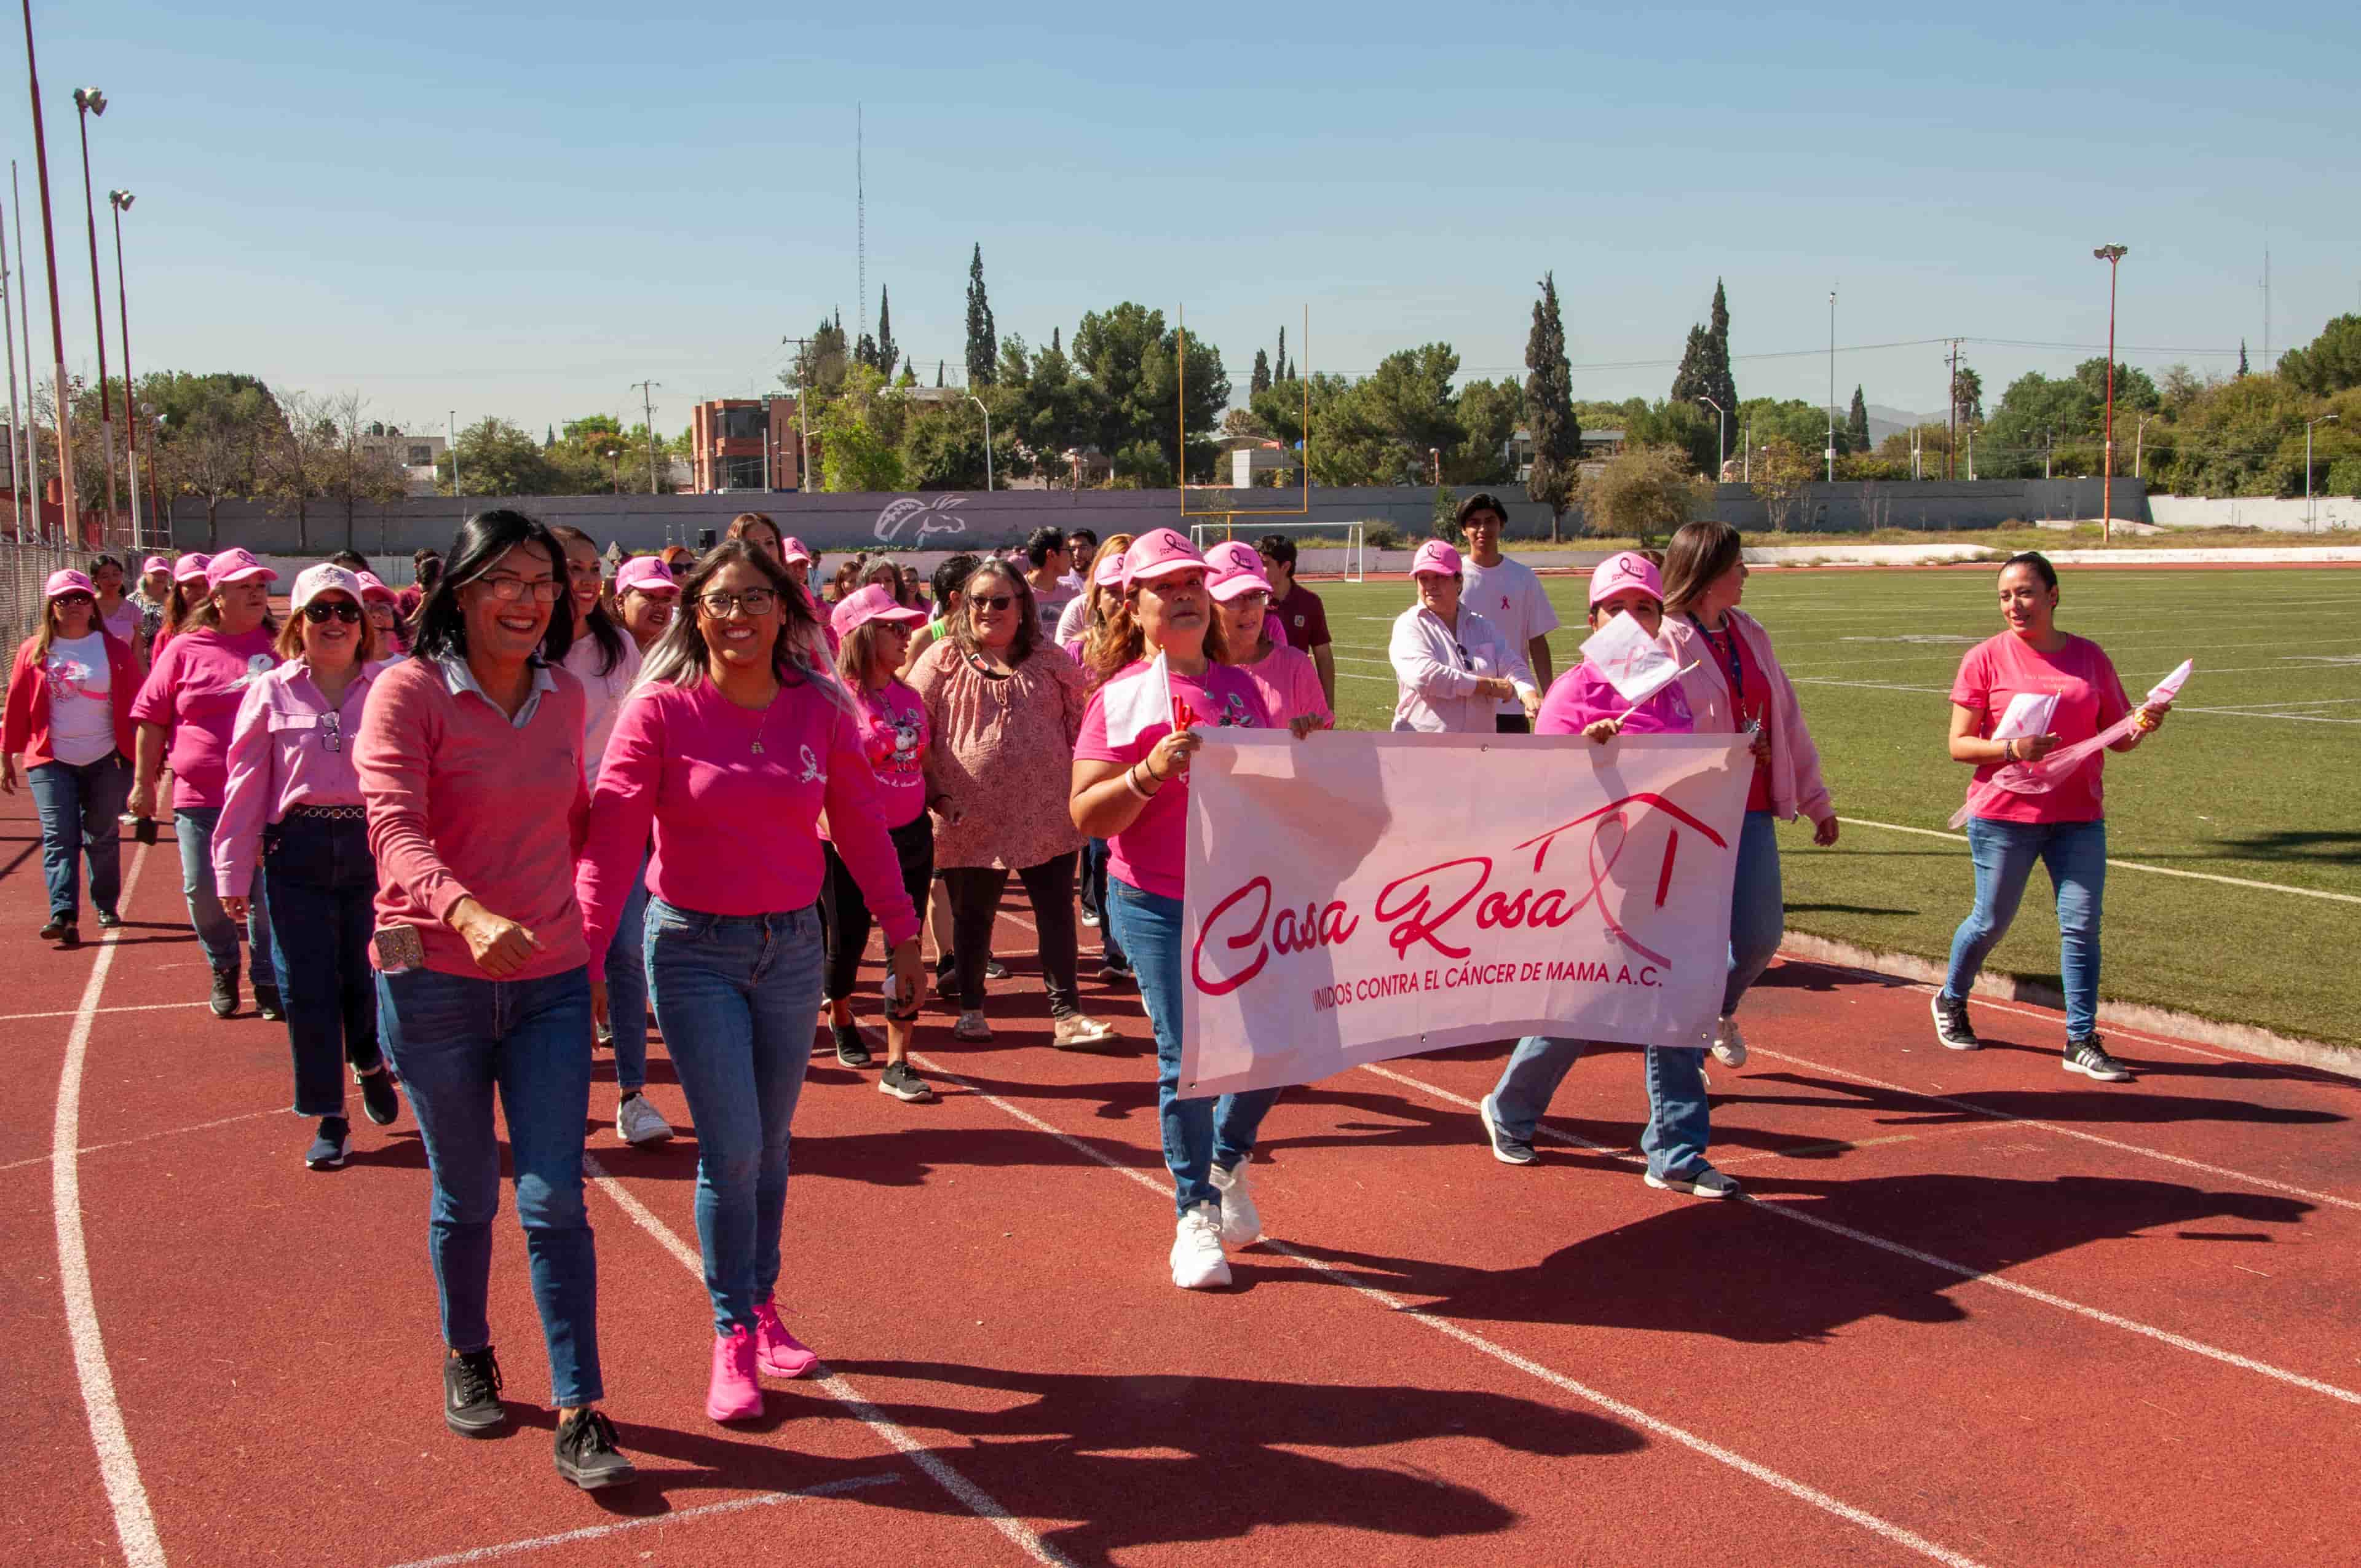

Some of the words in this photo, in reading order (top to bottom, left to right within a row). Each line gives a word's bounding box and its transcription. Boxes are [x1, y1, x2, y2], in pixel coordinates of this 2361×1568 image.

[1192, 875, 1359, 996] Casa
[1375, 856, 1577, 960] Rosa
[1312, 982, 1352, 1012] UNIDOS
[1356, 972, 1419, 1001] CONTRA
[1423, 969, 1440, 991] EL
[1445, 960, 1516, 988] CÁNCER
[1519, 962, 1543, 982] DE
[1546, 960, 1609, 983] MAMA
[1616, 964, 1663, 987] A.C.
